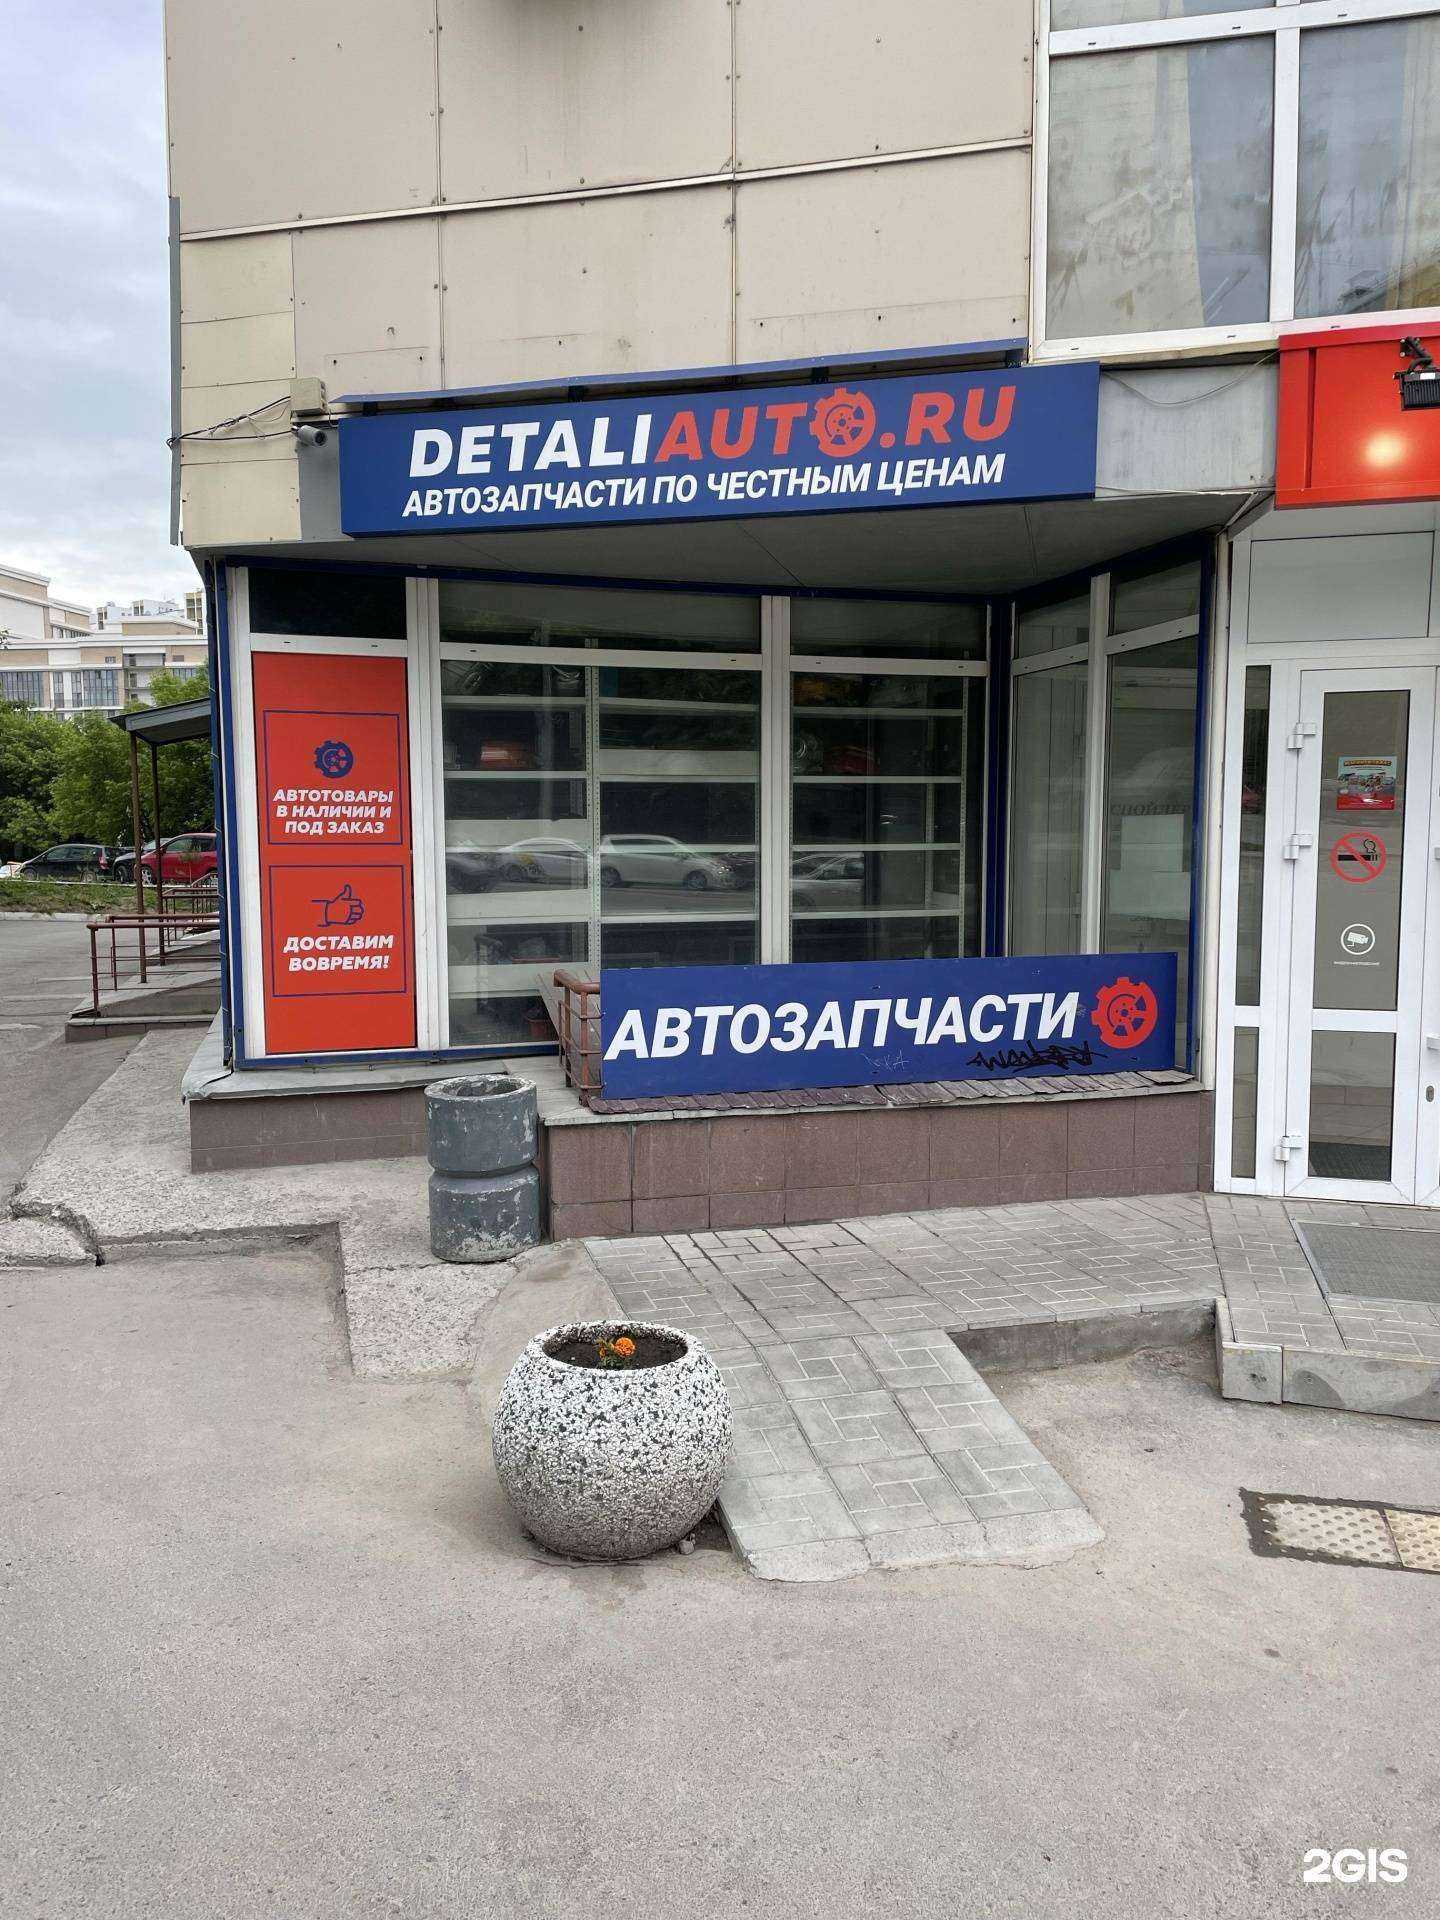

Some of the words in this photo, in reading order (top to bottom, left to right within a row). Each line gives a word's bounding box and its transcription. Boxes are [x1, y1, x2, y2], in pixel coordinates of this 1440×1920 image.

[402, 477, 647, 518] АВТОЗАПЧАСТИ
[652, 474, 698, 504] ПО
[707, 462, 872, 500] ЧЕСТНЫМ
[877, 453, 1006, 496] ЦЕНАМ
[272, 789, 394, 803] АВТОТОВАРЫ
[276, 805, 289, 818] В
[292, 805, 376, 818] НАЛИЧИИ
[380, 806, 392, 819] И
[285, 821, 323, 836] ПОД
[327, 821, 385, 834] ЗАКАЗ
[283, 935, 394, 954] ДОСТАВИМ
[288, 955, 390, 972] ВОВРЕМЯ!
[603, 991, 1079, 1061] АВТОЗАПЧАСТИ
